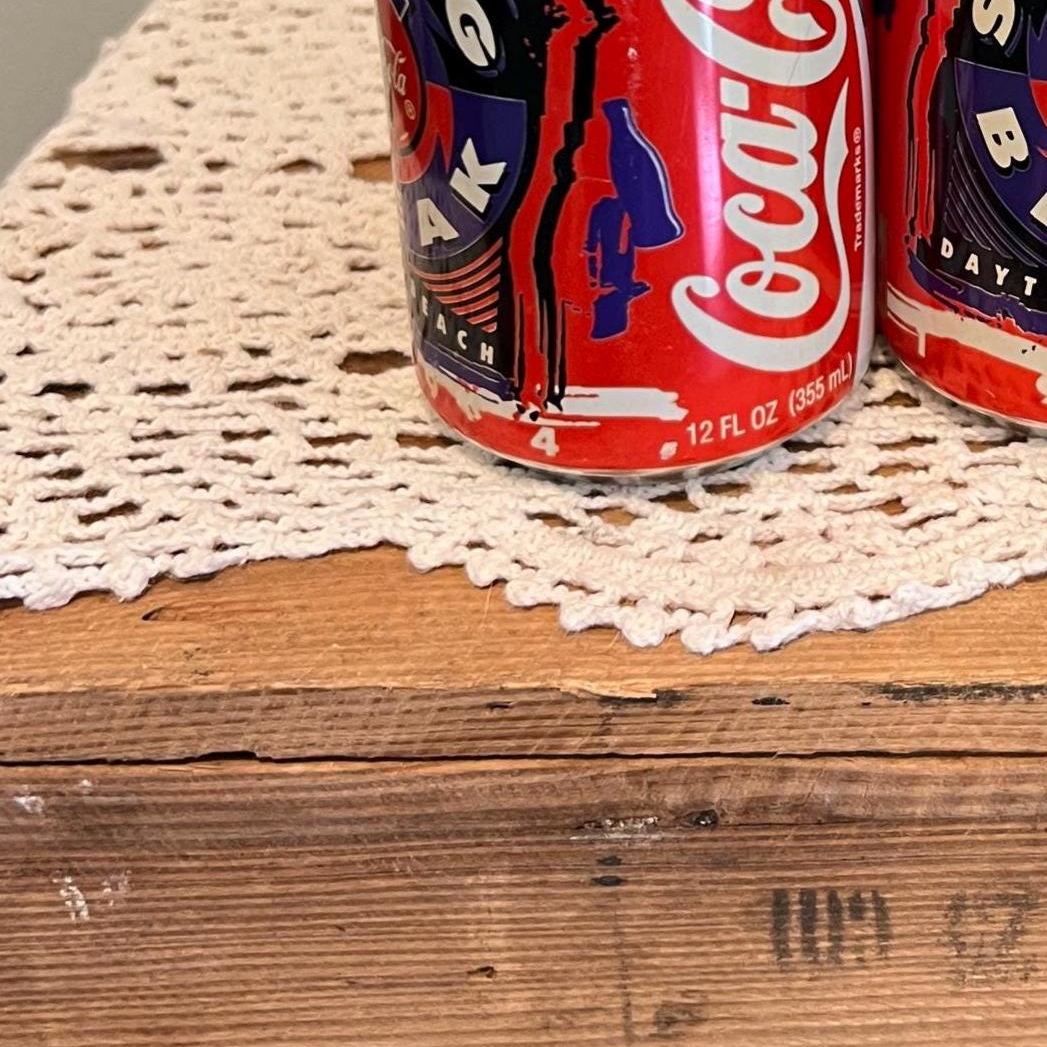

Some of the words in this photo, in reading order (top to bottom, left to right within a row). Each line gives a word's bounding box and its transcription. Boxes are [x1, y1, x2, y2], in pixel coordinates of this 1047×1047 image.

[686, 419, 715, 446] 12
[719, 404, 746, 440] FL
[751, 399, 779, 430] OZ
[788, 375, 825, 417] (355
[828, 351, 853, 391] mL)
